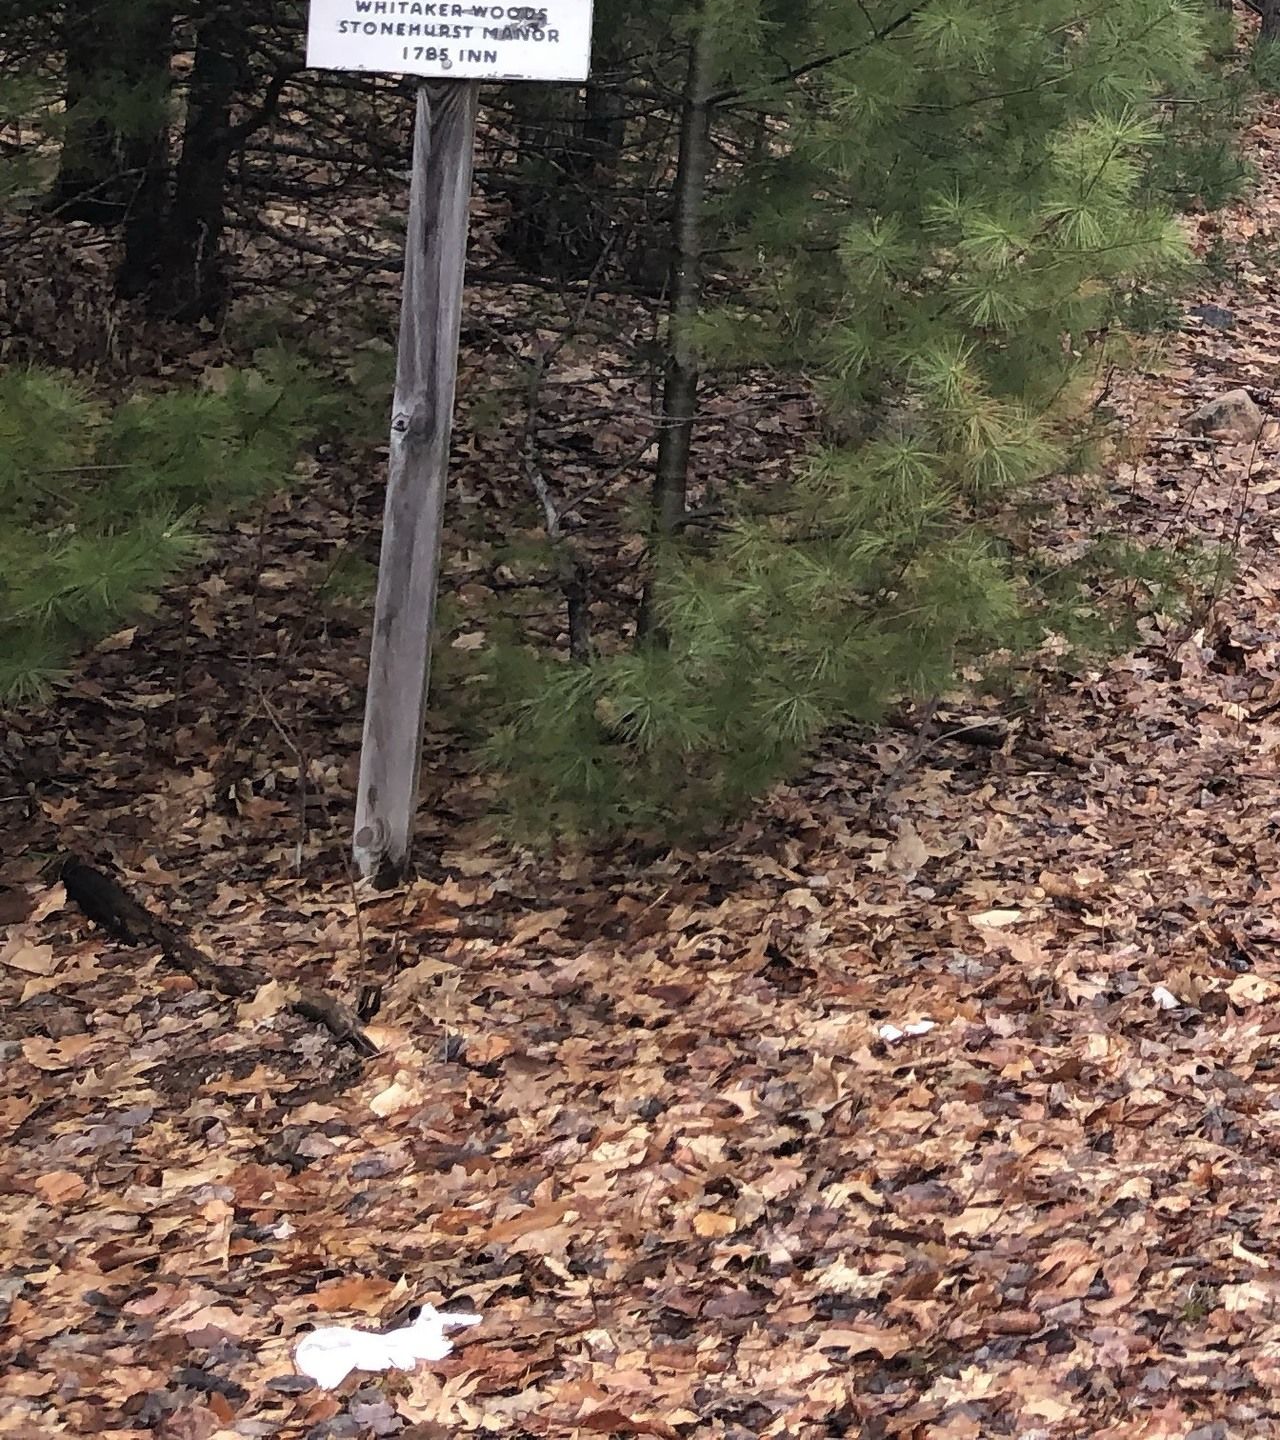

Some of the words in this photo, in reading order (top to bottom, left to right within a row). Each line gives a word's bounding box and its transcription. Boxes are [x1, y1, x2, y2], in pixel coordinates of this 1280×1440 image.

[472, 5, 548, 21] WOODS
[338, 20, 473, 39] STONEHURST
[483, 25, 560, 43] MANOR
[403, 46, 449, 62] 1785
[459, 50, 498, 63] INN
